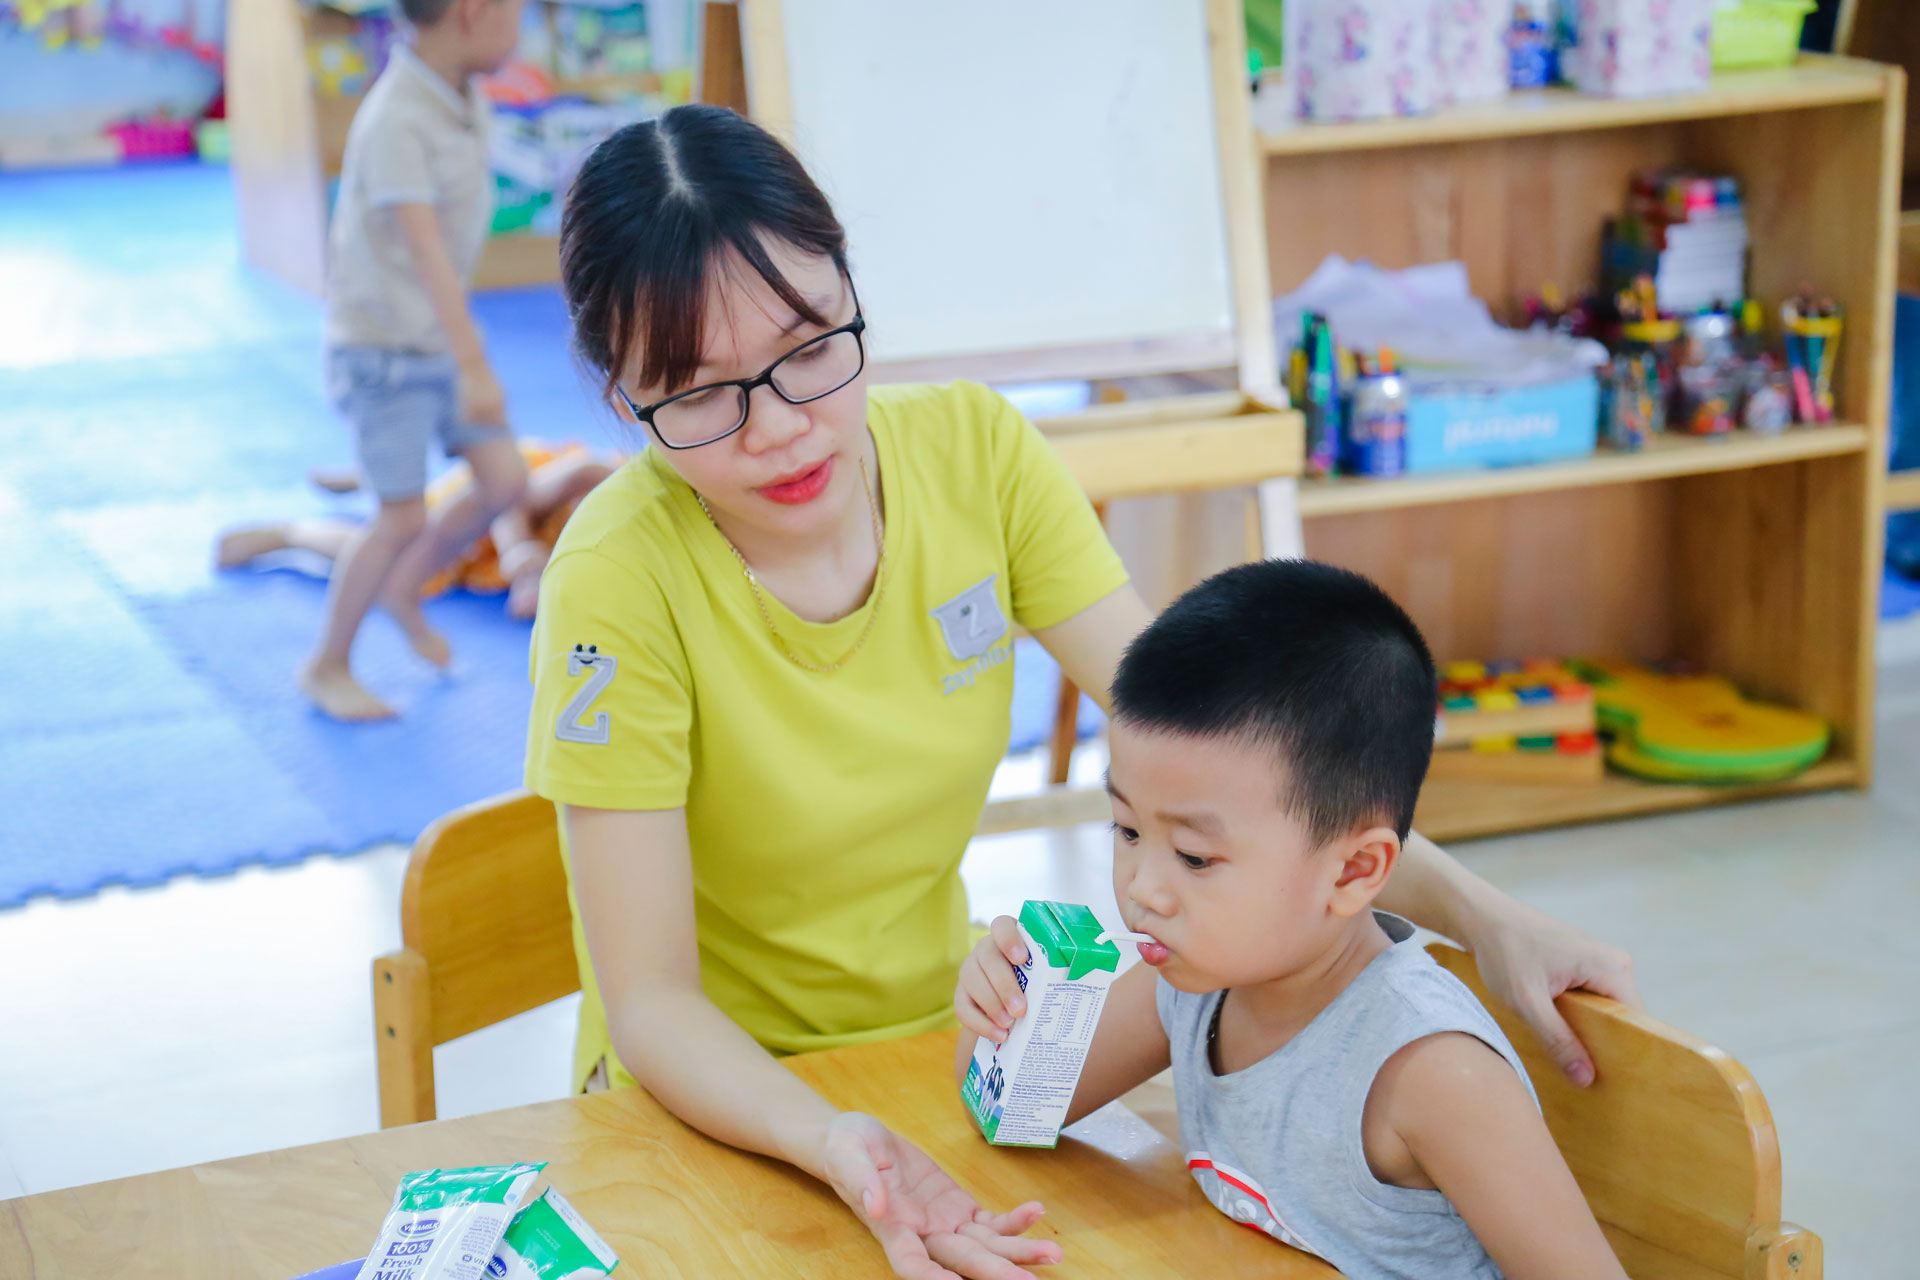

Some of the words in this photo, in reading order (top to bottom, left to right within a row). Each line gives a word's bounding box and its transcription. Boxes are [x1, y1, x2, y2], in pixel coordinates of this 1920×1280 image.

[555, 650, 618, 745] Z
[391, 1240, 431, 1256] 100%
[379, 1254, 424, 1269] Fresh
[371, 1267, 416, 1280] Milk
